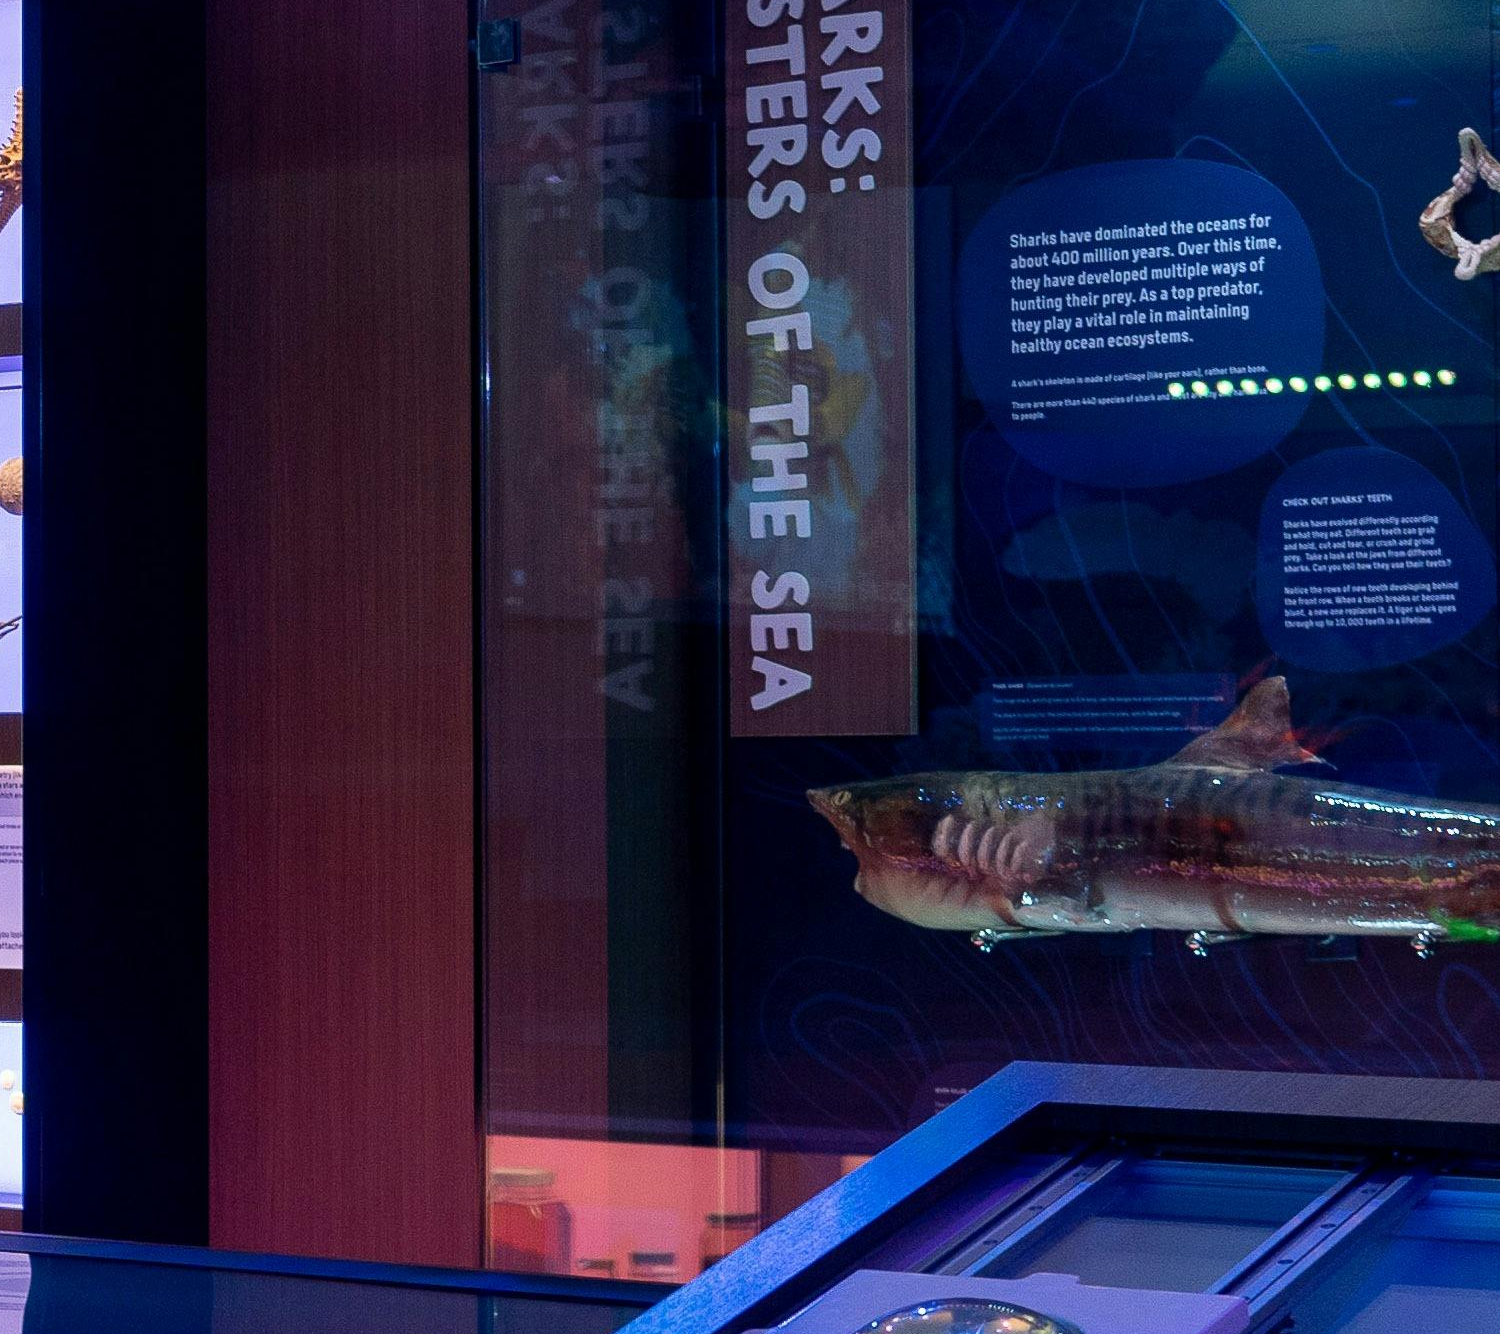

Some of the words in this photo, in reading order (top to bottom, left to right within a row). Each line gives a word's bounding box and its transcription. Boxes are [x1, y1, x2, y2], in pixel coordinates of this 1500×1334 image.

[1009, 232, 1057, 248] Sharks
[1060, 230, 1092, 243] have
[1094, 222, 1167, 241] dominated
[1170, 220, 1194, 235] the
[1196, 218, 1247, 233] oceans
[1248, 214, 1271, 228] for
[1010, 253, 1049, 269] about
[1051, 250, 1080, 265] 400
[1082, 247, 1129, 263] million
[1131, 246, 1174, 263] years.
[1177, 241, 1210, 256] Over
[1212, 238, 1242, 253] this
[1243, 236, 1282, 250] time,
[1010, 276, 1040, 292] they
[1043, 274, 1075, 287] have
[1077, 266, 1148, 285] developed
[1150, 262, 1209, 279] multiple
[1210, 261, 1247, 277] ways
[1249, 256, 1264, 272] of
[746, 252, 812, 353] OF
[1010, 295, 1062, 311] hunting
[1065, 292, 1099, 307] their
[1102, 292, 1136, 307] prey.
[1138, 287, 1157, 302] As
[1159, 289, 1168, 301] a
[1170, 285, 1194, 301] top
[1197, 281, 1263, 300] predator,
[1011, 318, 1041, 334] they
[1043, 316, 1072, 333] play
[1074, 317, 1083, 328] a
[1085, 311, 1116, 327] vital
[1119, 310, 1146, 325] role
[1149, 308, 1163, 323] in
[1165, 304, 1249, 321] maintaining
[1011, 338, 1062, 354] healthy
[1064, 337, 1104, 350] ocean
[1106, 330, 1194, 348] ecosystems.
[750, 383, 812, 539] THE
[750, 570, 815, 711] SEA
